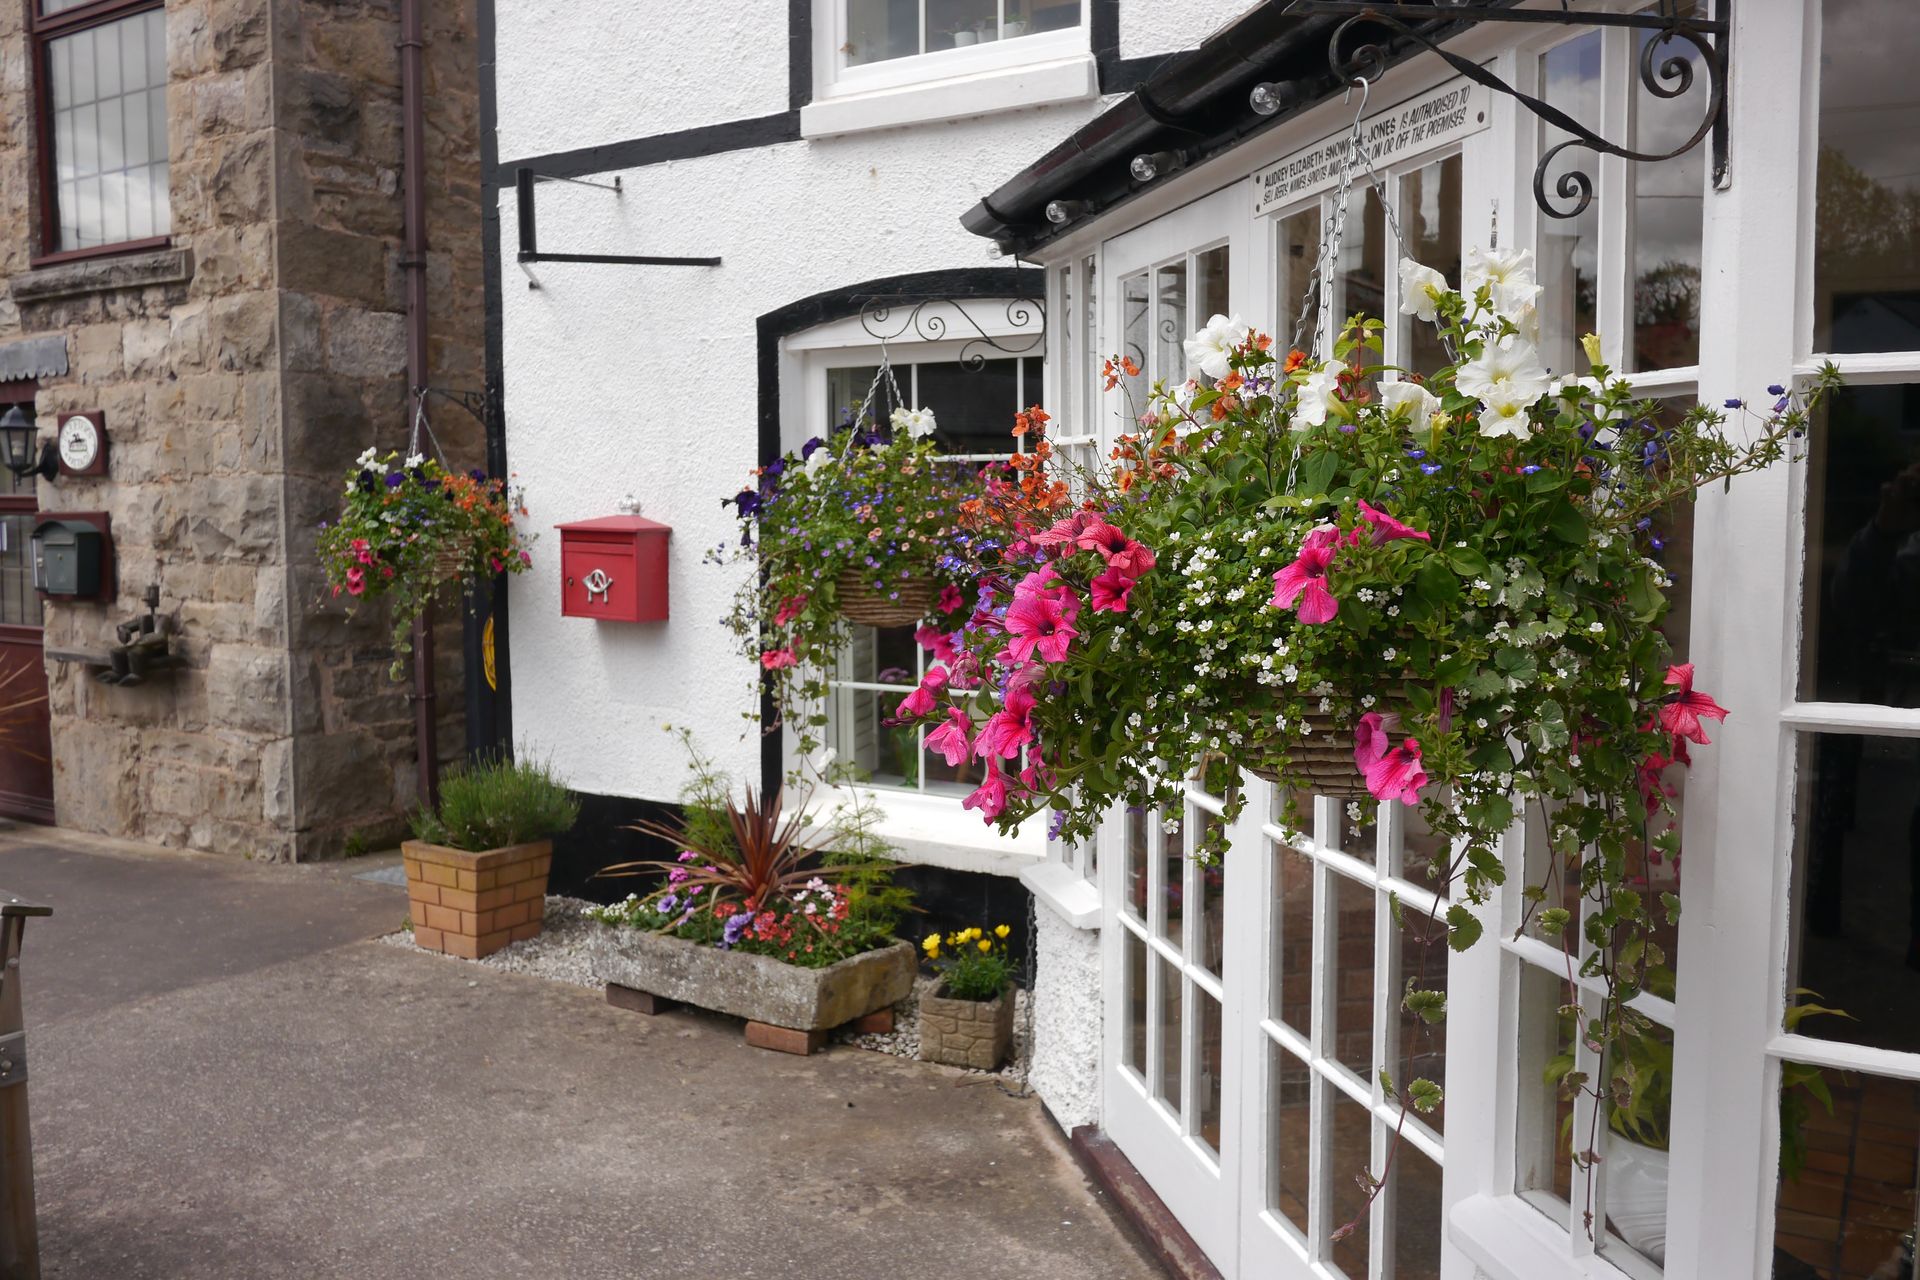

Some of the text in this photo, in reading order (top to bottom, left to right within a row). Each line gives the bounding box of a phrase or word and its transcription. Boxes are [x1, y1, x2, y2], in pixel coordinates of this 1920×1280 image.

[1264, 165, 1289, 188] AUDREY
[1289, 149, 1323, 177] ELIZABETH
[1326, 117, 1396, 161] SNOW-JONES
[1400, 111, 1408, 130] IS
[1409, 90, 1458, 127] AUTHORISED
[1460, 85, 1470, 105] TO
[1307, 165, 1327, 187] SPIRITS
[1327, 159, 1341, 178] AND
[1372, 141, 1382, 160] ON
[1383, 137, 1394, 155] OR
[1396, 130, 1410, 150] OFF
[1411, 124, 1426, 144] THE
